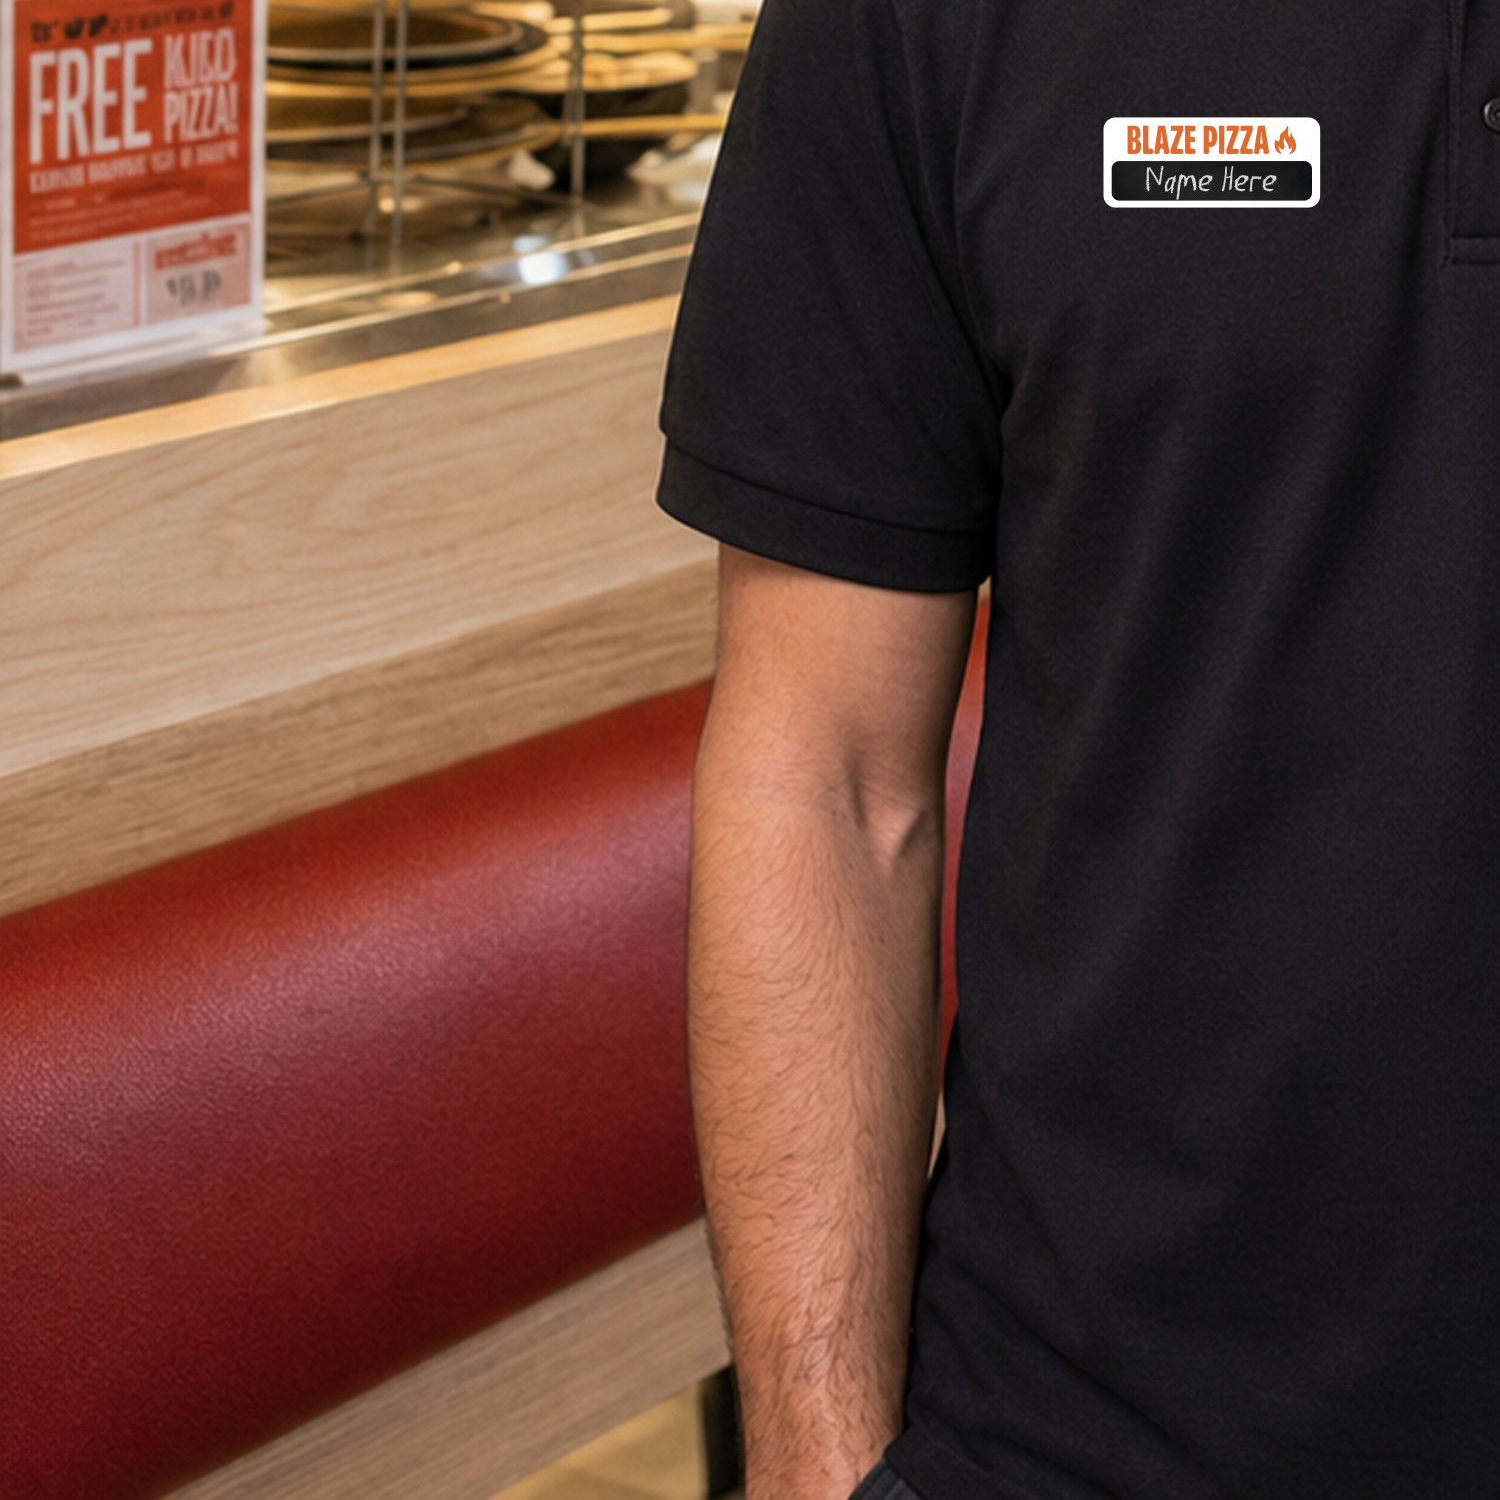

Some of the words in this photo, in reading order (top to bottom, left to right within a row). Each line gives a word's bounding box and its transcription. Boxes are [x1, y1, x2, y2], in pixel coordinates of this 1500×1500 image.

[29, 37, 153, 165] FREE
[163, 81, 239, 145] PIZZA!
[1126, 125, 1196, 155] BLAZE
[1203, 125, 1270, 155] PIZZA
[1145, 165, 1213, 200] Name
[1221, 165, 1277, 192] Here
